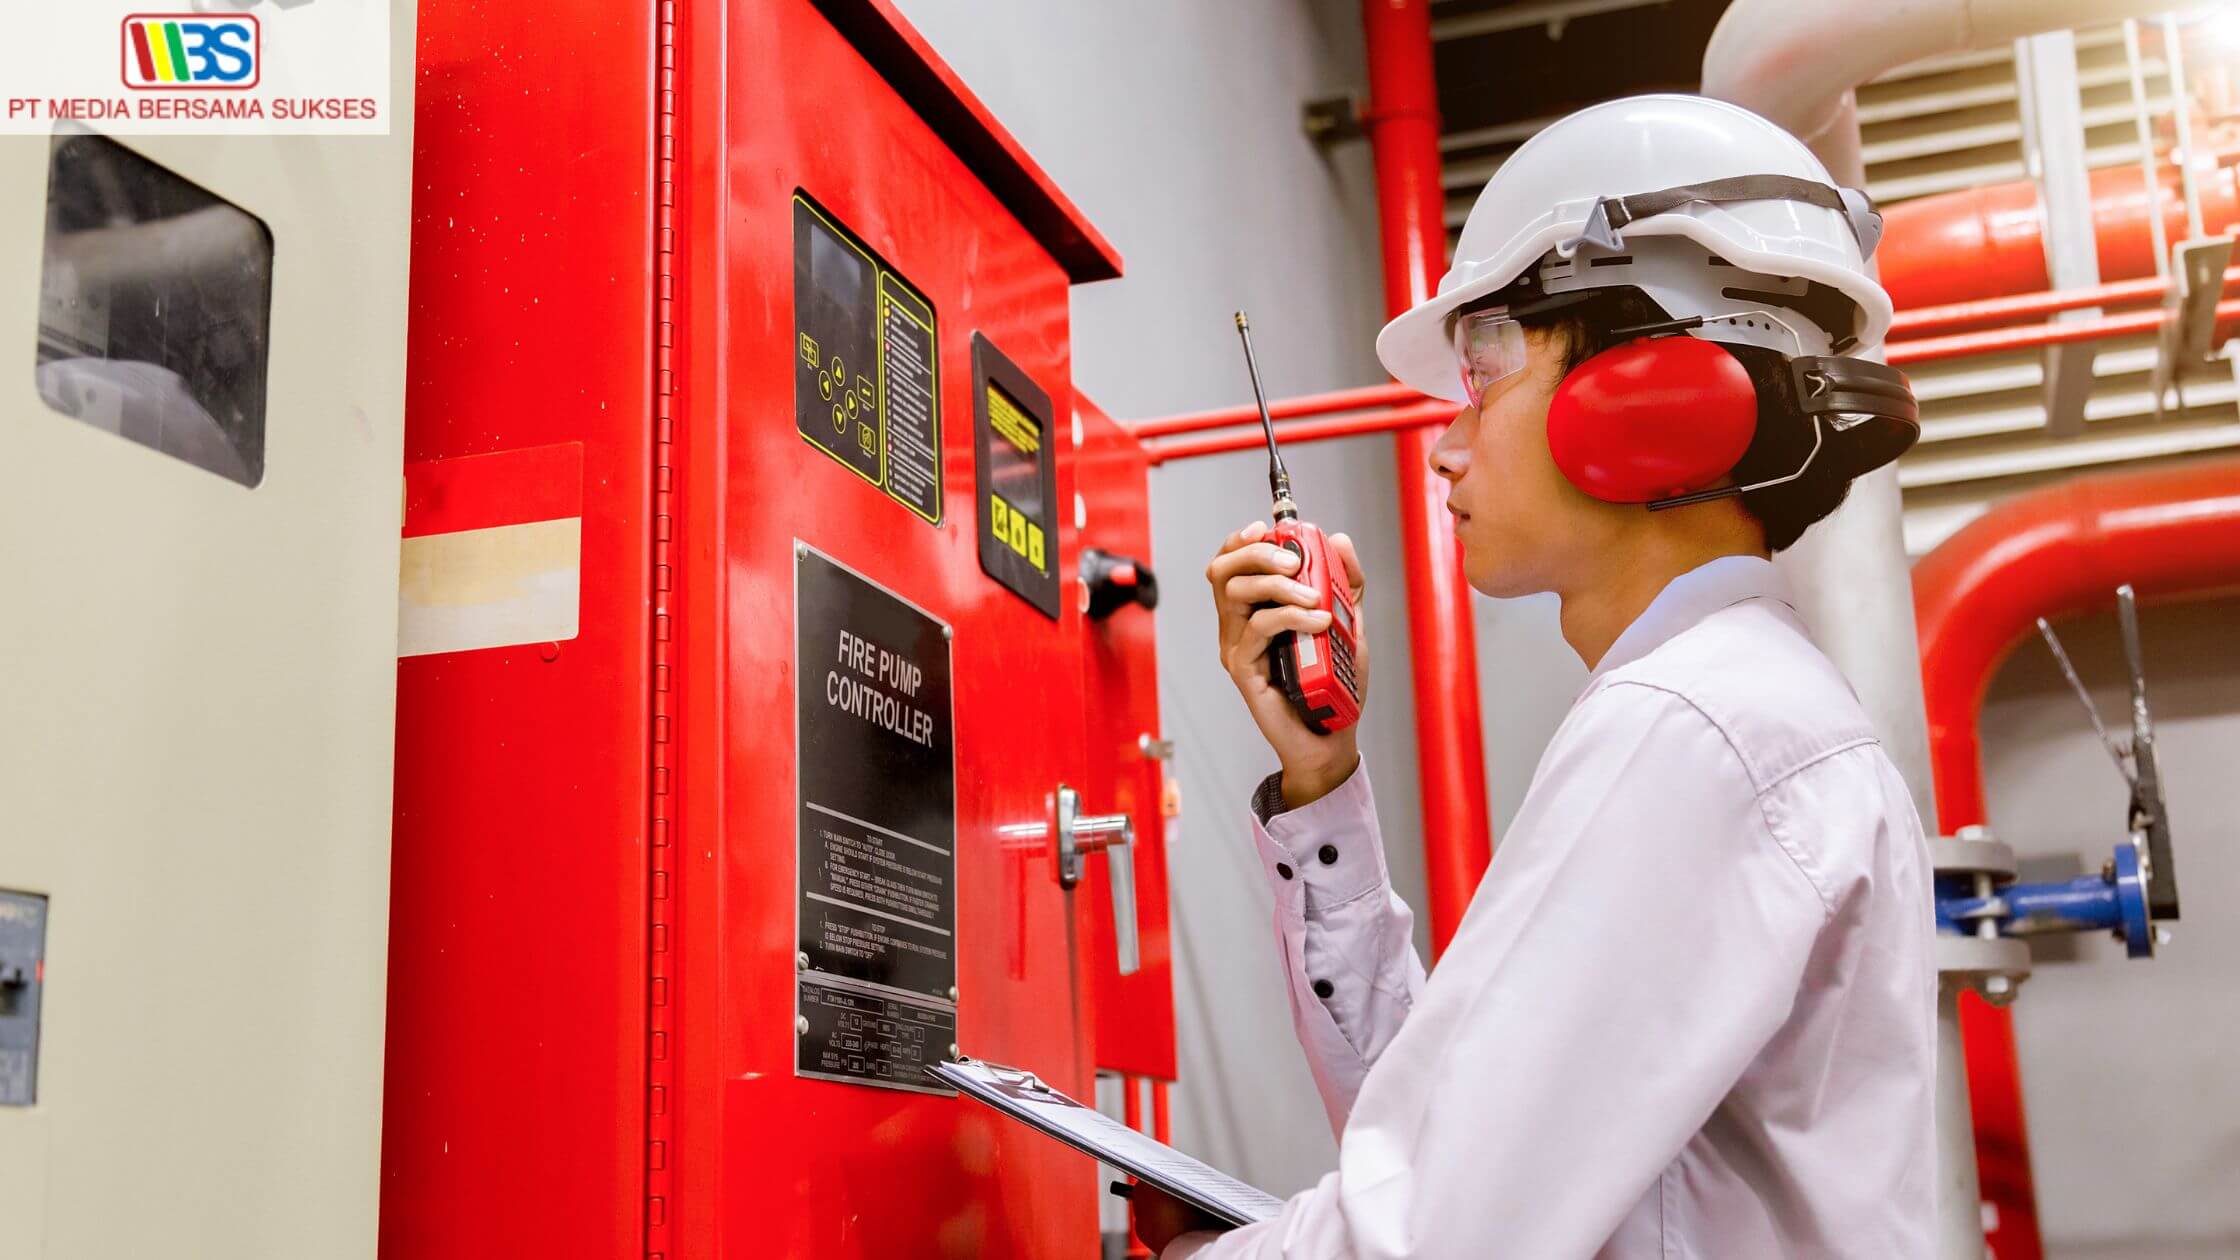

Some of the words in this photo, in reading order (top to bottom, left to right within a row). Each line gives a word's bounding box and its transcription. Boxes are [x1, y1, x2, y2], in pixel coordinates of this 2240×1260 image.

[838, 629, 876, 678] FIRE
[879, 649, 921, 697] PUMP
[827, 670, 933, 748] CONTROLLER
